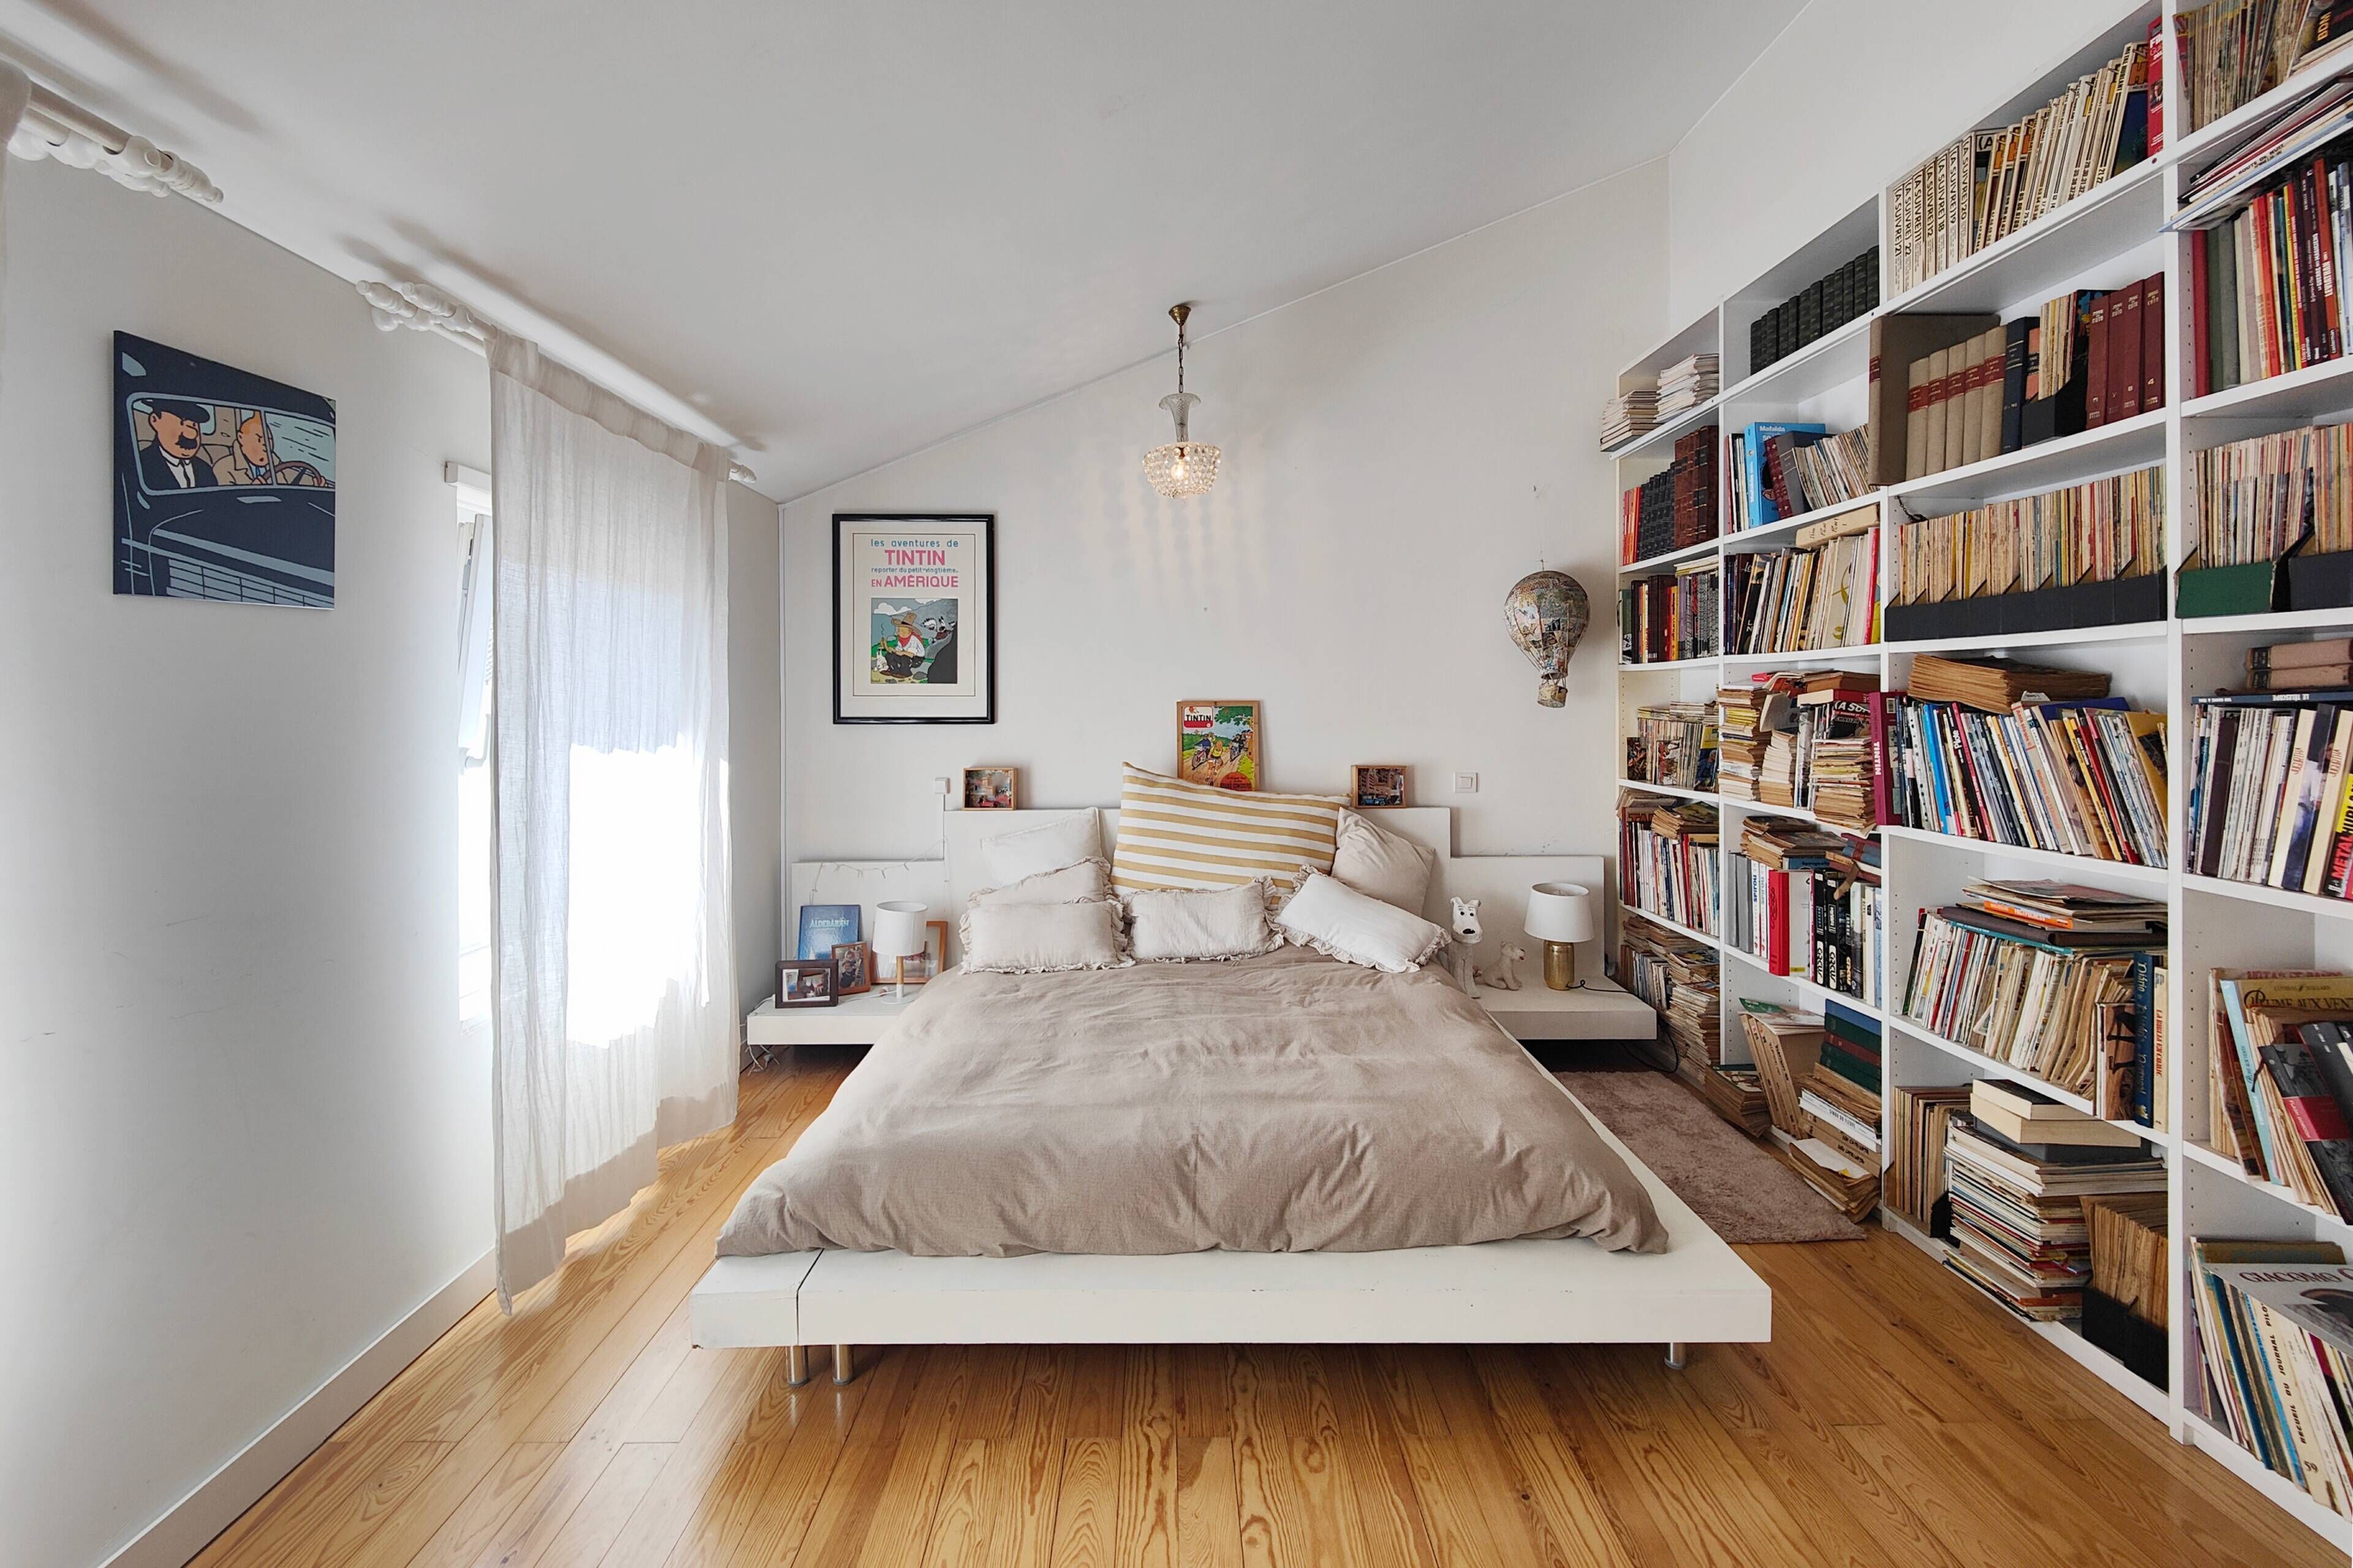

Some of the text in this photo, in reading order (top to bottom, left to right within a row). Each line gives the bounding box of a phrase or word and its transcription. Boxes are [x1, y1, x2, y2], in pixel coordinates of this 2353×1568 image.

[2123, 47, 2131, 65] METAL
[885, 550, 945, 566] TINTIN
[871, 575, 959, 588] EN AMÉRIQUE
[1953, 730, 1963, 749] Pilote
[2291, 747, 2305, 775] JUGURTHA
[2329, 749, 2342, 778] JUGURTHA
[2331, 834, 2353, 879] METAL
[2137, 962, 2148, 992] Diário
[2298, 998, 2323, 1009] AUX
[2323, 998, 2353, 1010] VENT
[2156, 1010, 2162, 1018] LA
[2156, 1043, 2162, 1053] EN
[2289, 1100, 2311, 1140] FLASH GORDON
[2239, 1272, 2343, 1282] GIACOMO
[2261, 1303, 2307, 1444] RECUEIL DU JOURNAL PILO
[2304, 1461, 2318, 1471] 59
